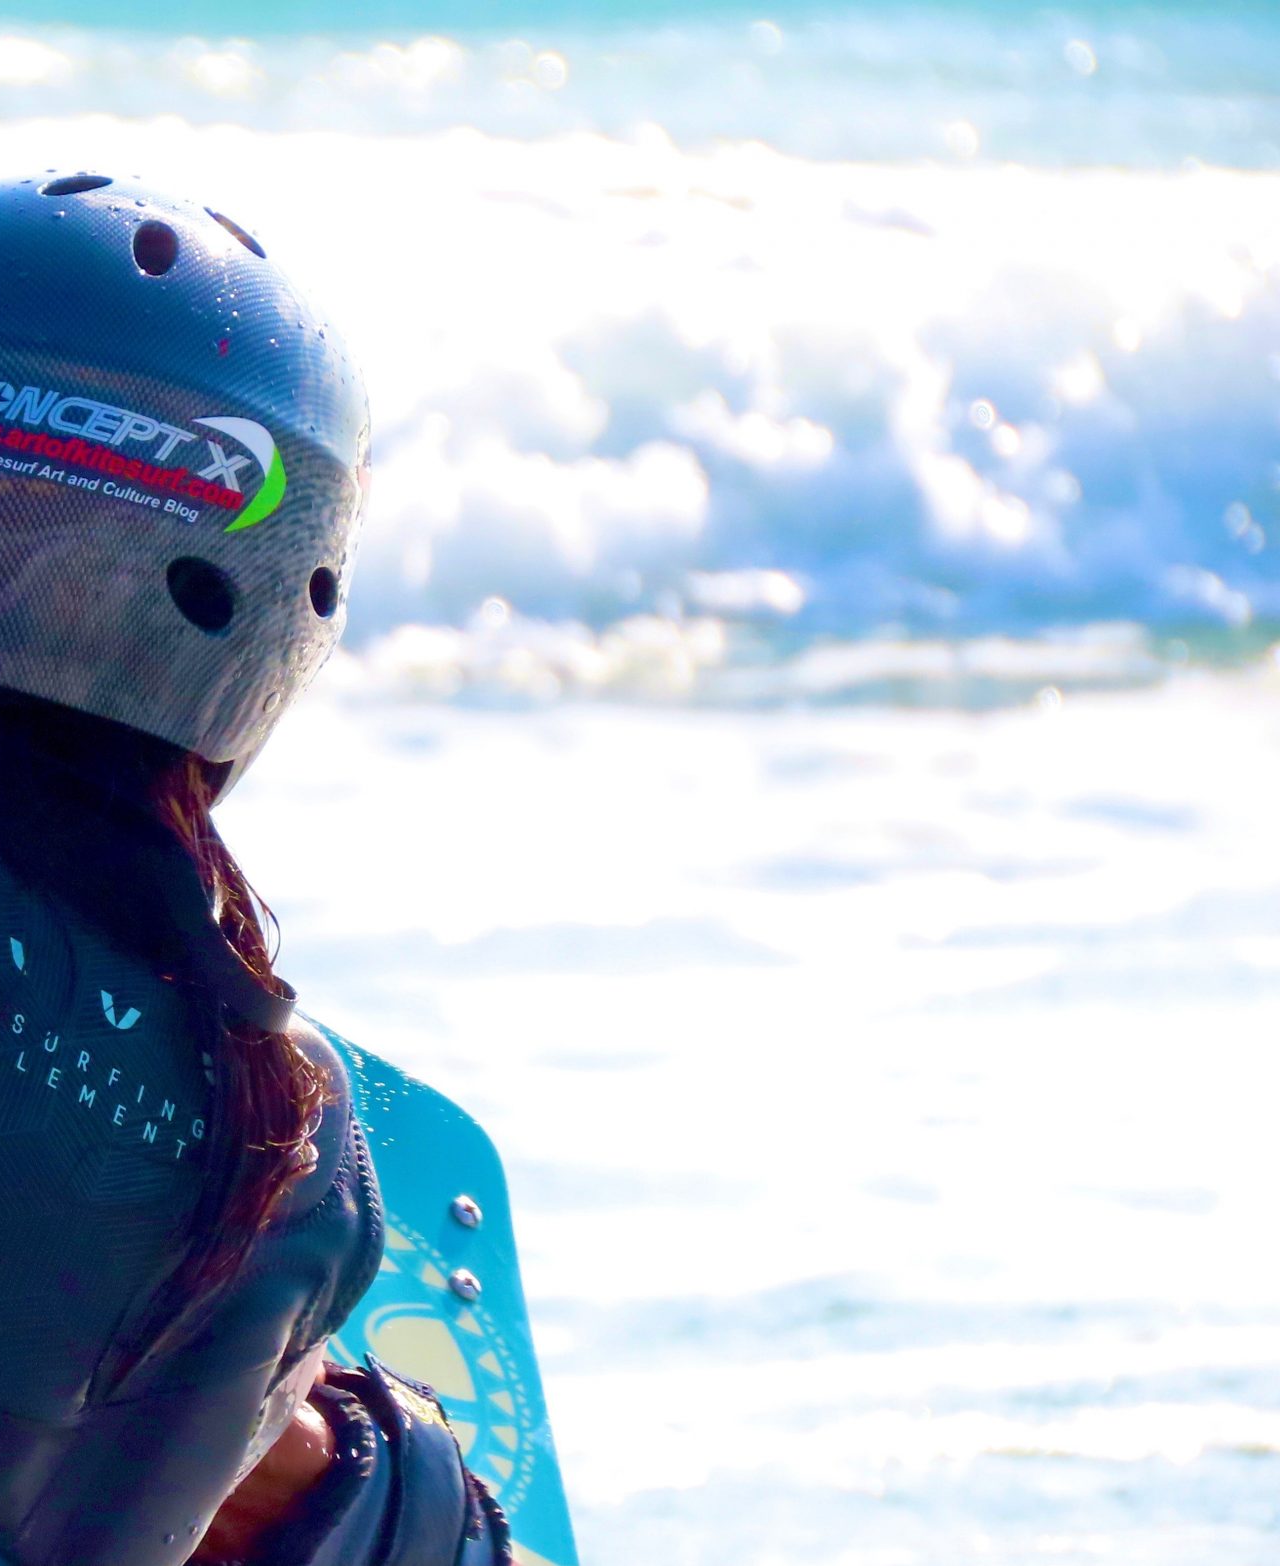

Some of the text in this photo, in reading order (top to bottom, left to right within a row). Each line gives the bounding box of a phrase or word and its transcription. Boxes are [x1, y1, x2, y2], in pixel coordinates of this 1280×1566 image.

[197, 439, 251, 492] X
[38, 465, 64, 481] Art
[67, 474, 100, 491] and
[103, 481, 161, 508] Culture
[164, 499, 199, 522] Blog
